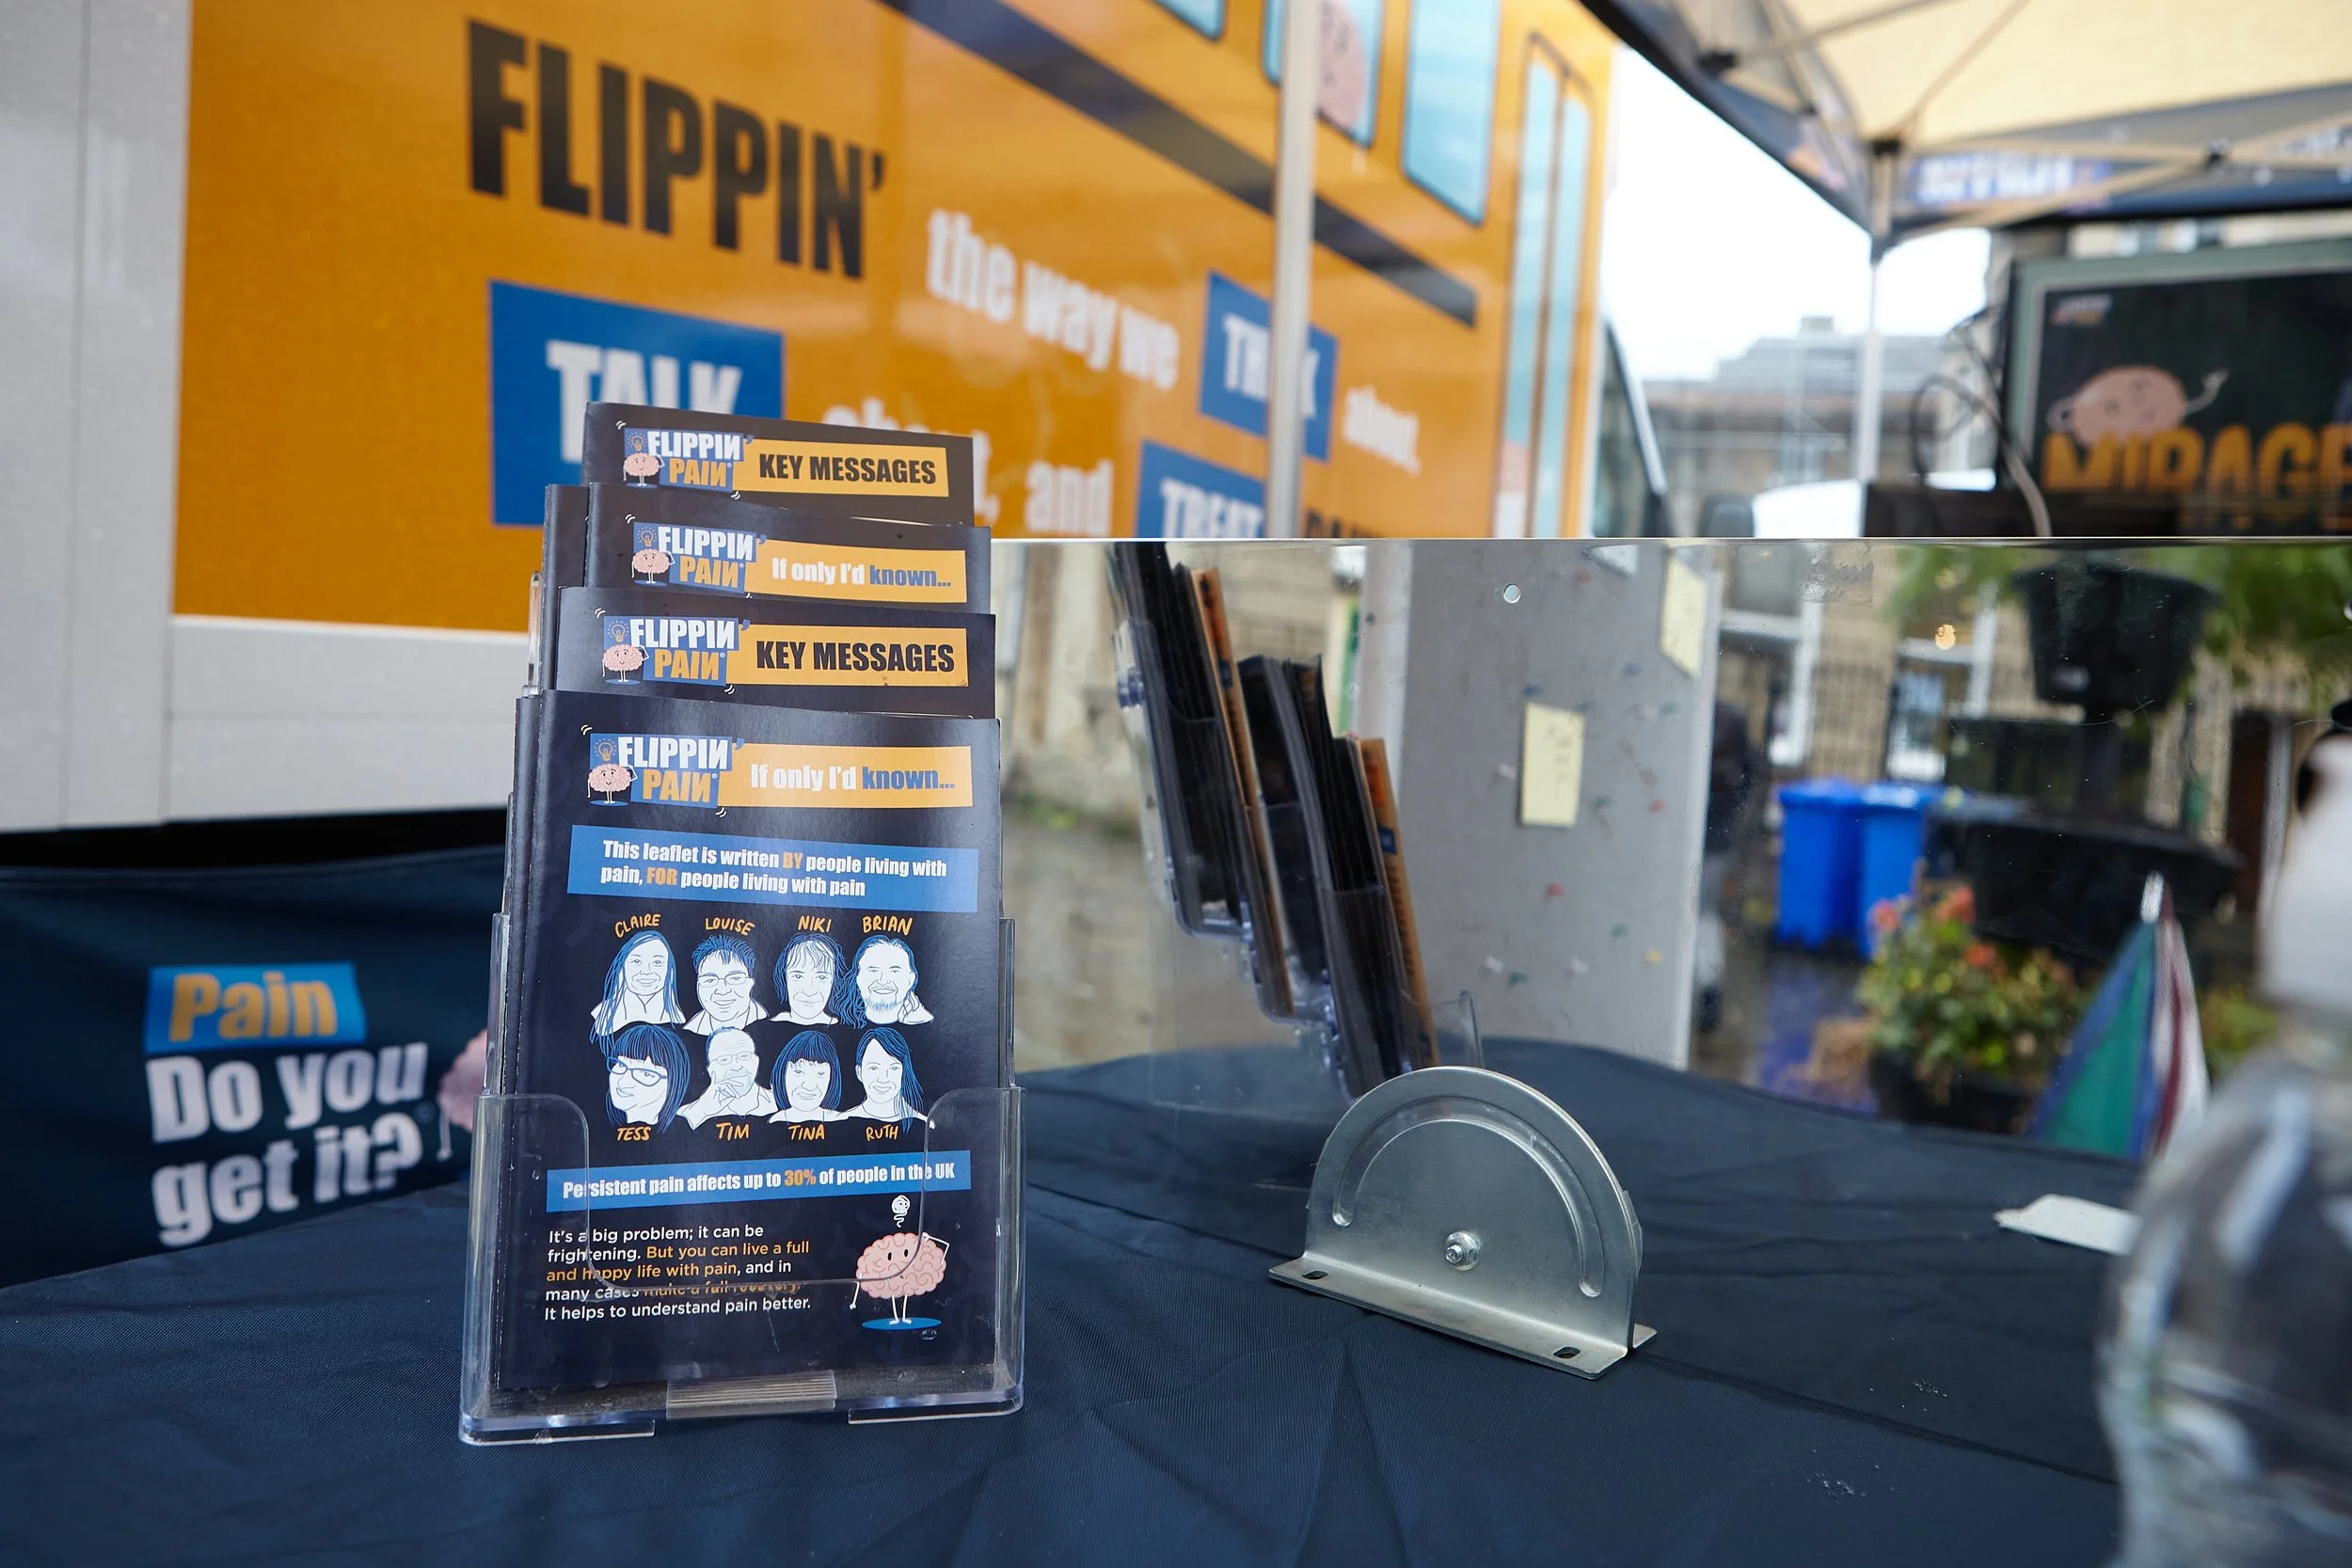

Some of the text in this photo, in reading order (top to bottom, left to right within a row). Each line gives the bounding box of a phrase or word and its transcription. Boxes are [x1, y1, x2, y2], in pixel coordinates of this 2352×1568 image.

[467, 17, 886, 280] FLIPPIN'
[928, 207, 1016, 324] the
[1024, 258, 1118, 371] way
[1120, 303, 1181, 391] we
[759, 453, 936, 483] KEY MESSAGES
[1025, 458, 1114, 536] and
[771, 557, 951, 587] If only I'd known...
[756, 641, 955, 673] KEY MESSAGES
[751, 764, 955, 792] If only I'd known...
[603, 840, 947, 877] This leaflet is written BY people living with
[600, 865, 866, 896] pain, FOR people living with pain
[614, 913, 914, 939] CLAIRE LOUISE NIKI BRIAN
[168, 972, 338, 1042] Pain
[146, 1042, 429, 1144] Do you
[617, 1122, 899, 1142] TESS TIM TINA RUTH
[151, 1112, 423, 1248] get it?
[563, 1163, 955, 1198] Persistent pain affects up to 30% of people in the UK
[549, 1230, 573, 1243] It's
[593, 1228, 618, 1243] big
[623, 1227, 693, 1243] problem;
[698, 1226, 708, 1239] it
[713, 1227, 739, 1238] can
[744, 1225, 764, 1237] be
[646, 1245, 674, 1259] But
[678, 1246, 707, 1259] you
[711, 1244, 738, 1257] can
[742, 1243, 769, 1256] live
[772, 1244, 782, 1255] a
[787, 1241, 809, 1254] full
[547, 1268, 577, 1282] and
[637, 1264, 661, 1278] life
[666, 1263, 699, 1276] with
[704, 1261, 740, 1277] pain,
[745, 1259, 773, 1275] and
[778, 1259, 791, 1273] in
[545, 1296, 811, 1322] It helps to understand pain better.
[546, 1288, 590, 1302] many
